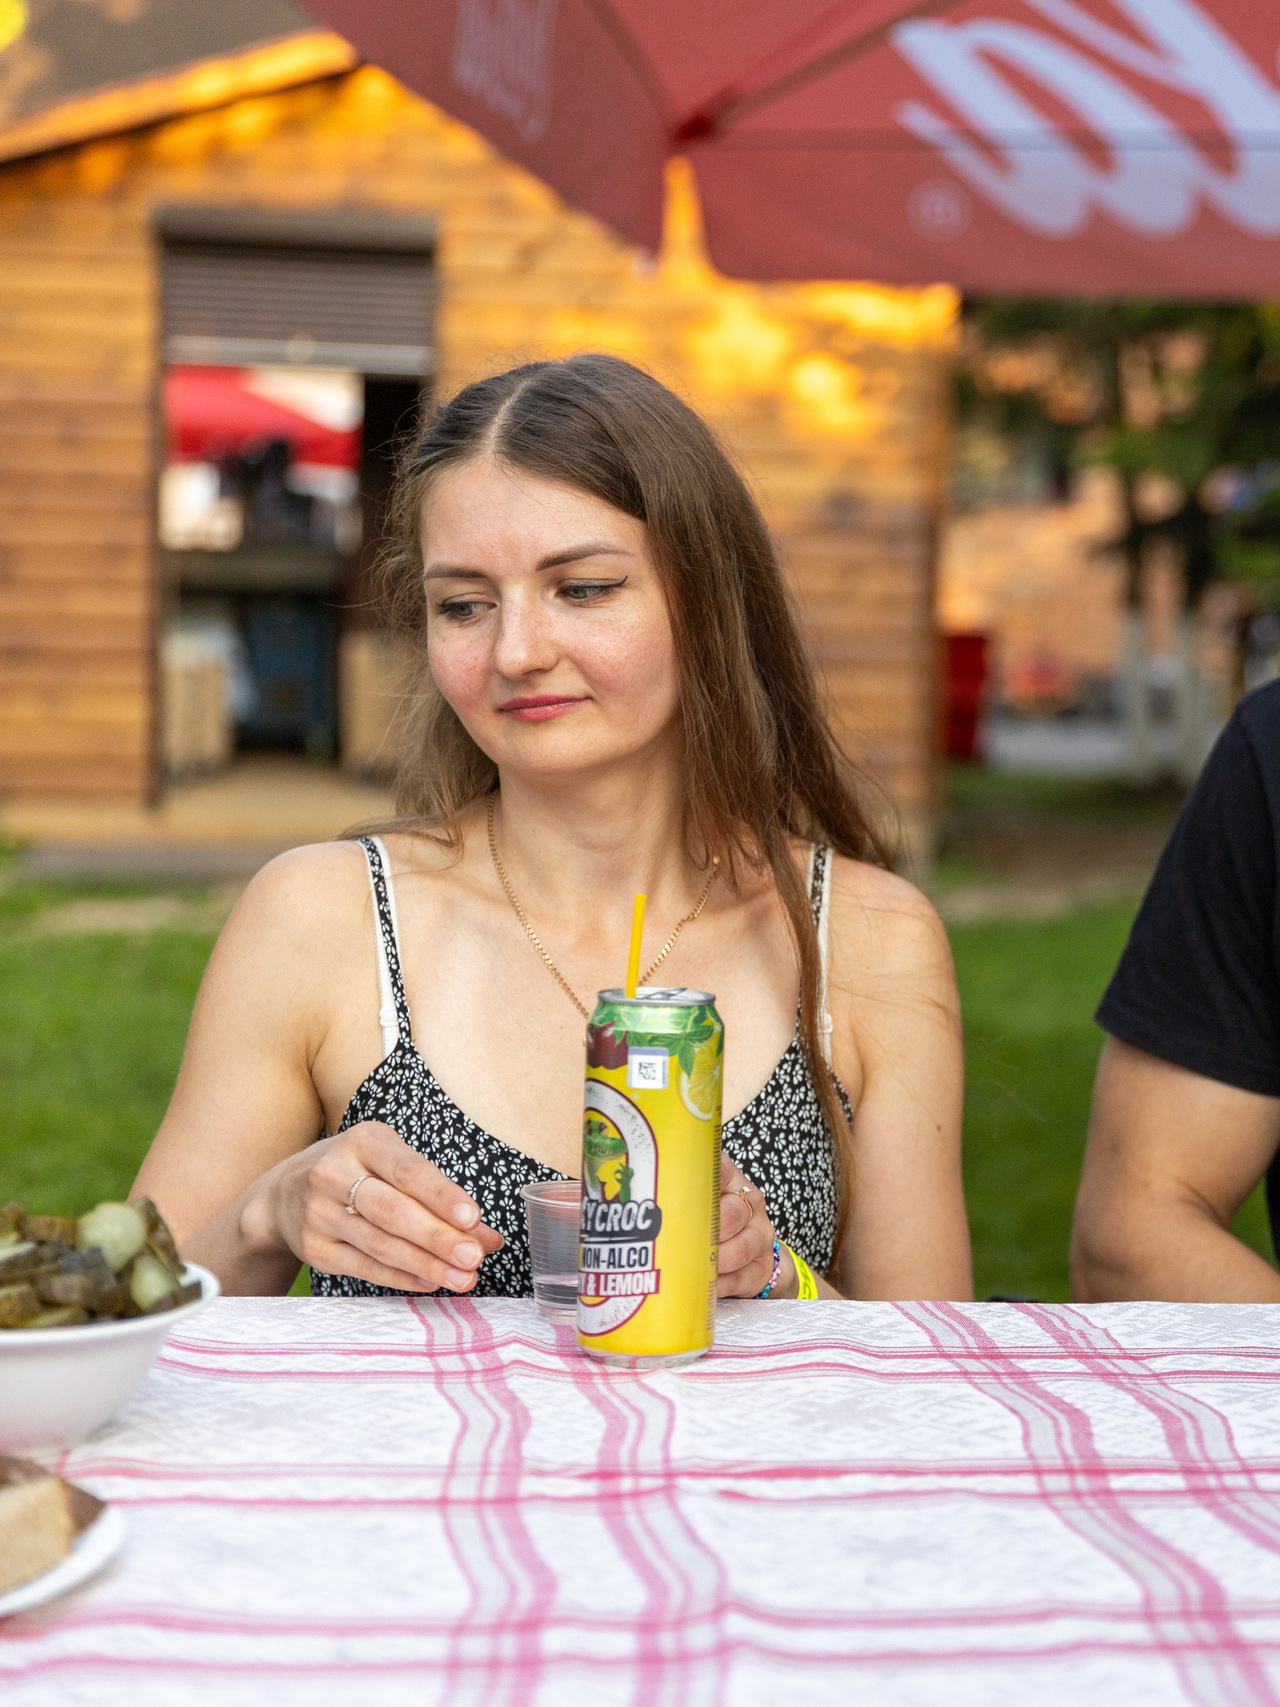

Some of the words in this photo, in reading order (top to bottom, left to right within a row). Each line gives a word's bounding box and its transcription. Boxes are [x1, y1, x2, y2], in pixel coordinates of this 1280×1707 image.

[582, 1246, 649, 1269] NON-ALCO
[587, 1273, 596, 1296] &
[599, 1271, 656, 1296] LEMON
